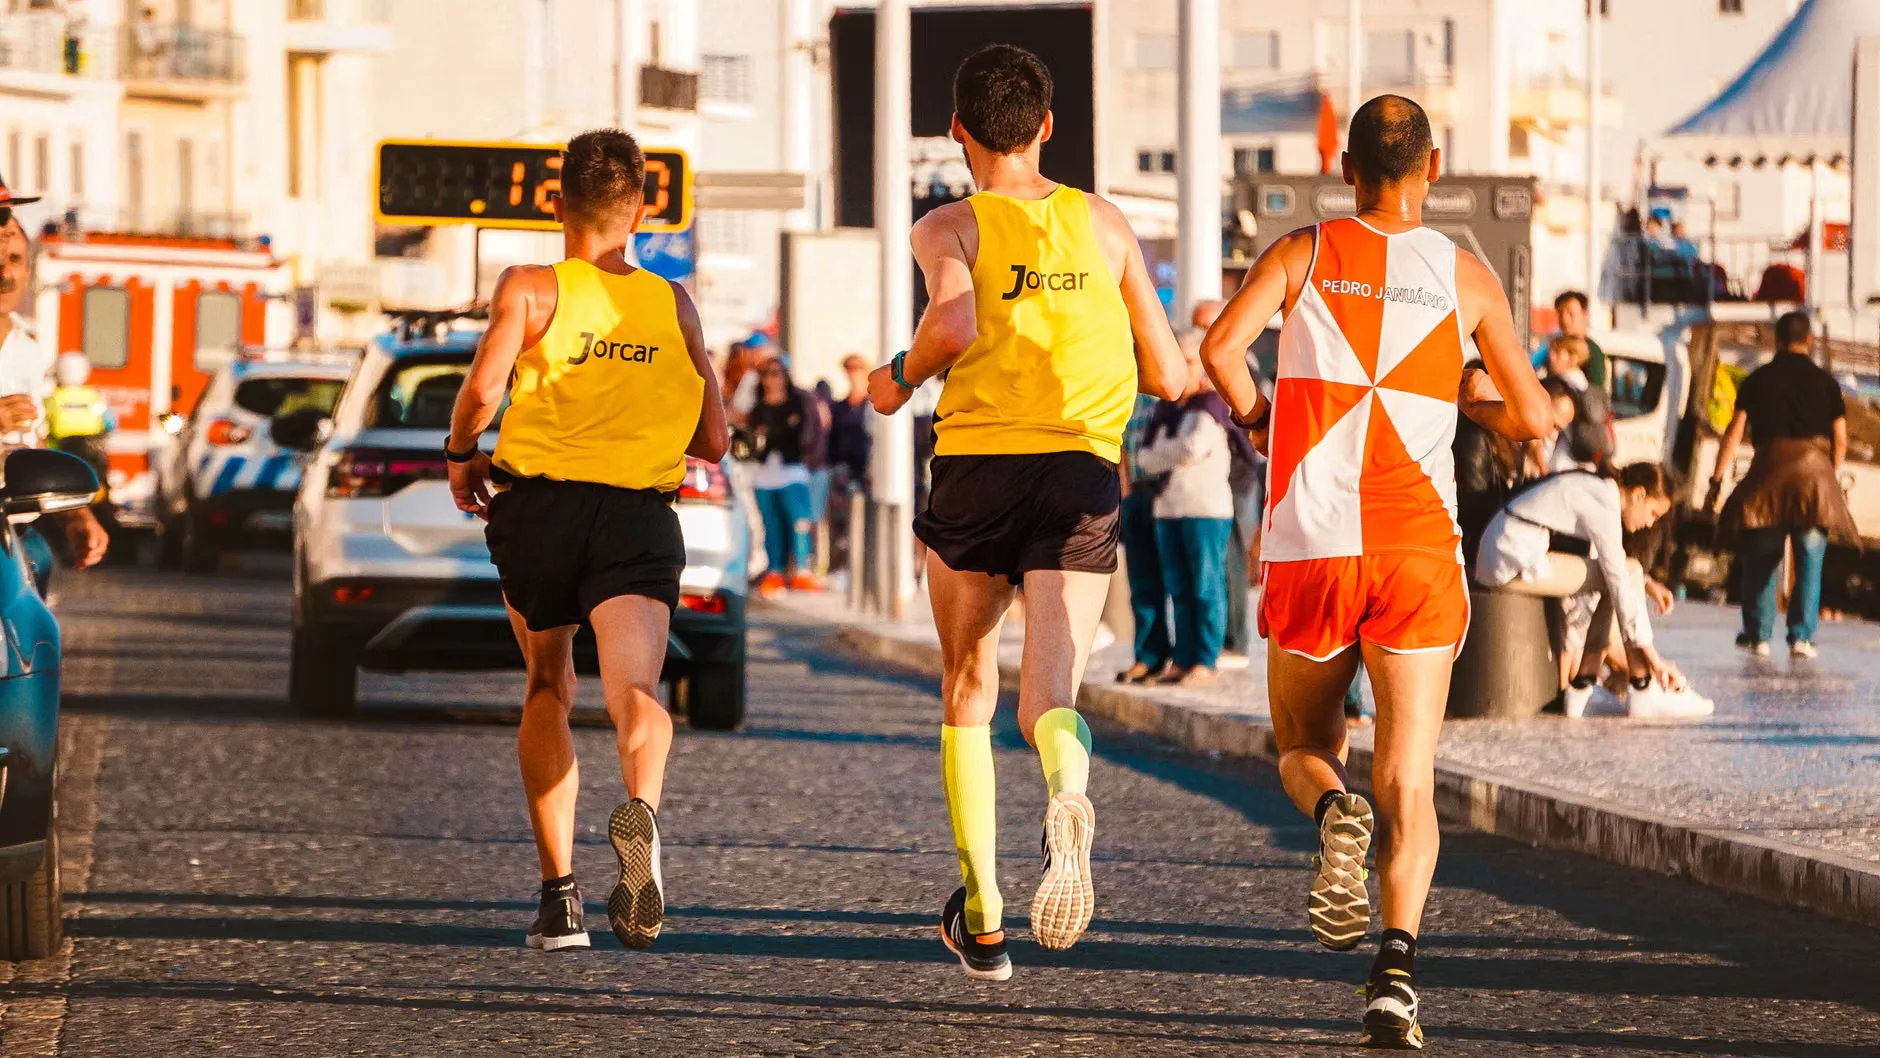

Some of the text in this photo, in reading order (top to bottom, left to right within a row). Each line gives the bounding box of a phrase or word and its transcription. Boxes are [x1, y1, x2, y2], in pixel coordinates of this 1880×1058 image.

[1001, 264, 1089, 301] Jorcar
[1321, 279, 1449, 311] PEDRO JANUÁRIO
[566, 331, 660, 366] Jorcar
